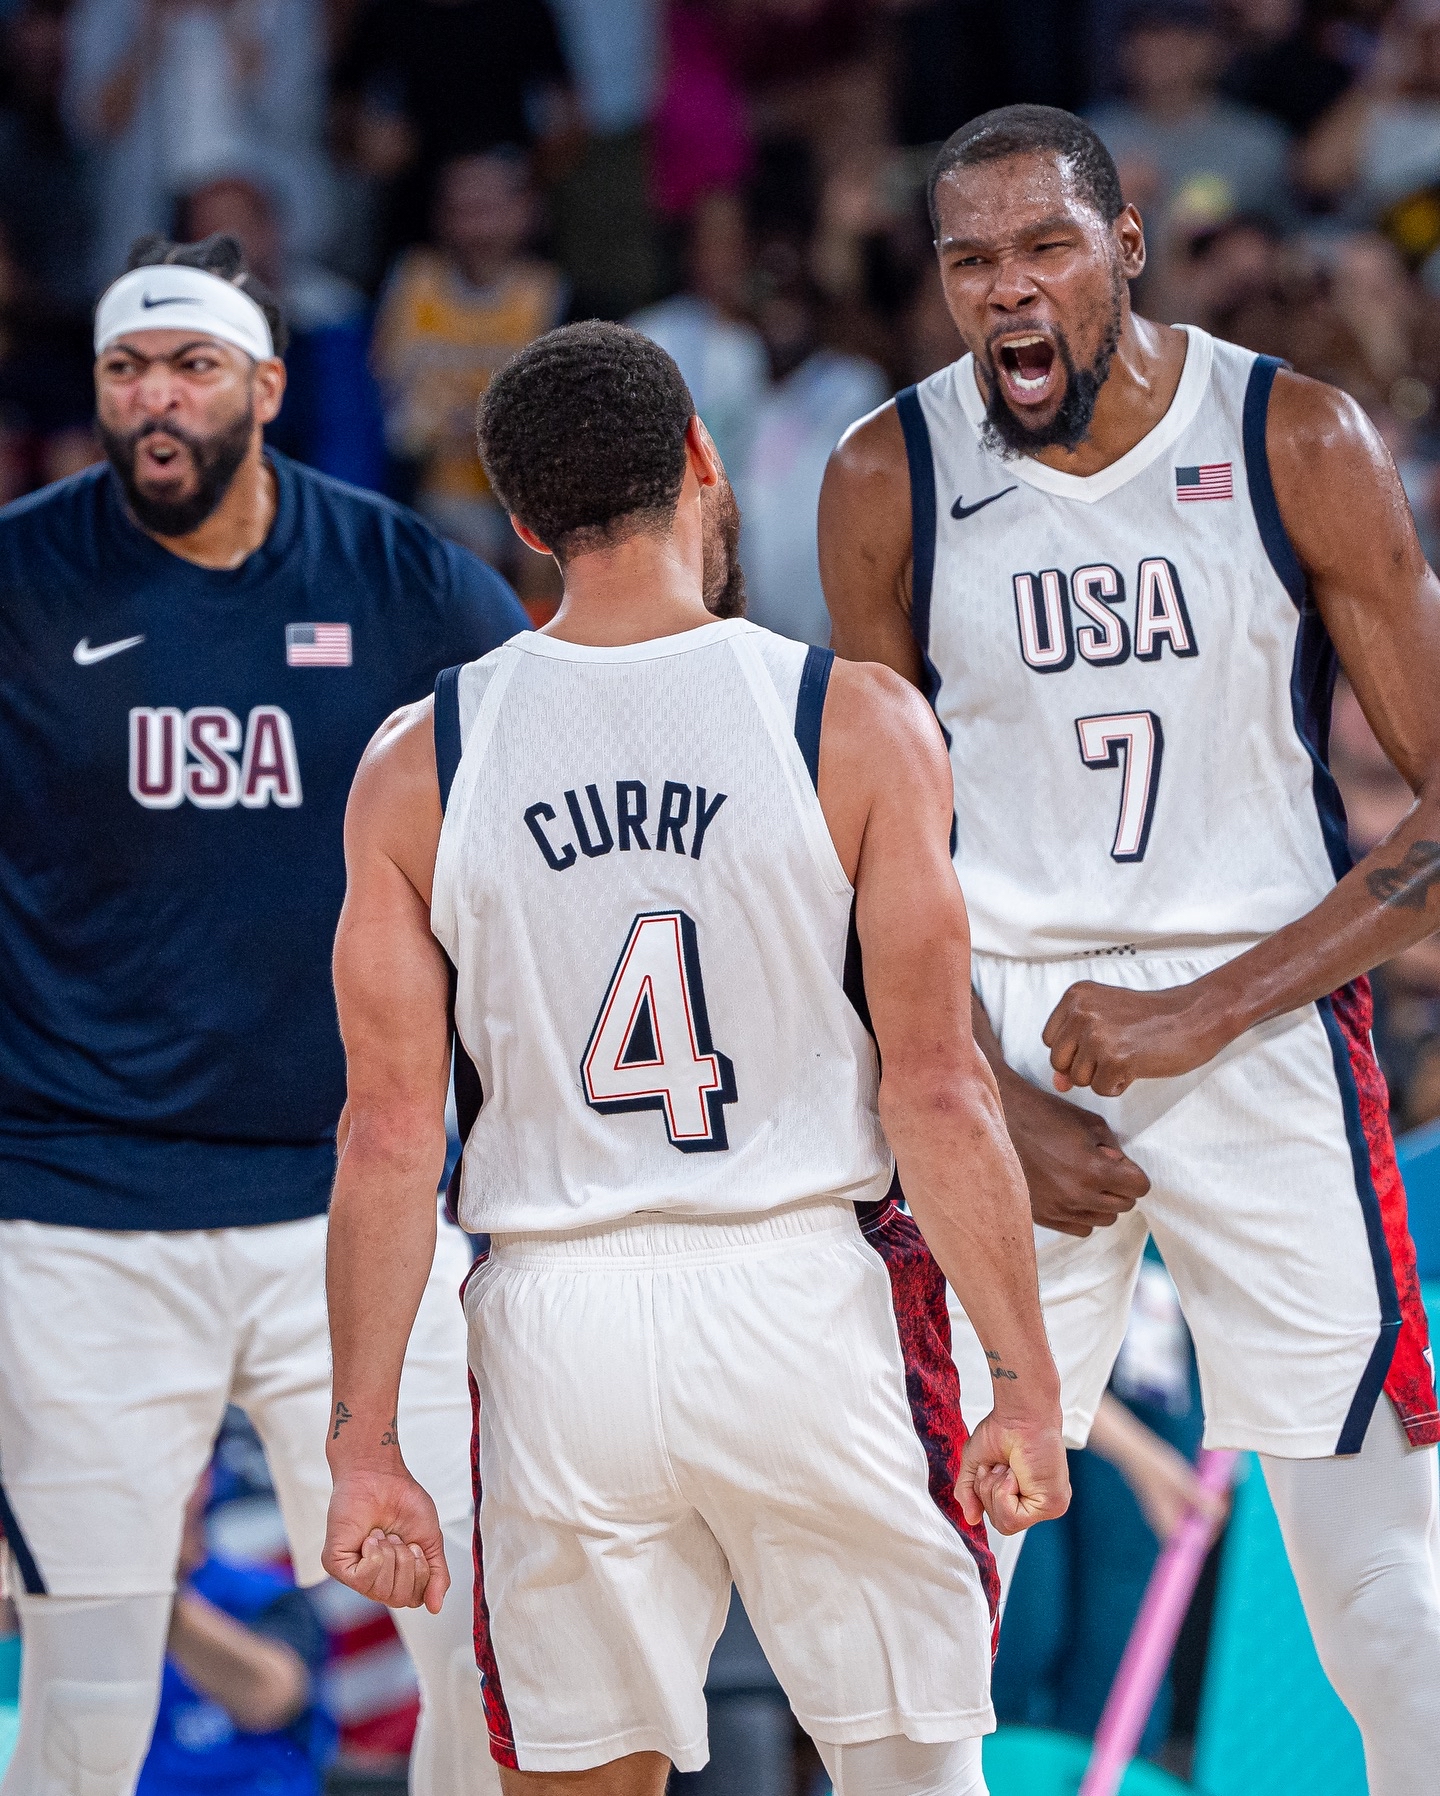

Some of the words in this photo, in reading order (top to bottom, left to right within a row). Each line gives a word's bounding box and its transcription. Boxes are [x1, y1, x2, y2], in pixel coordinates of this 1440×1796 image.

[1013, 557, 1199, 673] USA
[128, 706, 303, 809] USA
[1075, 710, 1164, 863] 7
[523, 780, 728, 872] CURRY
[580, 909, 738, 1154] 4
